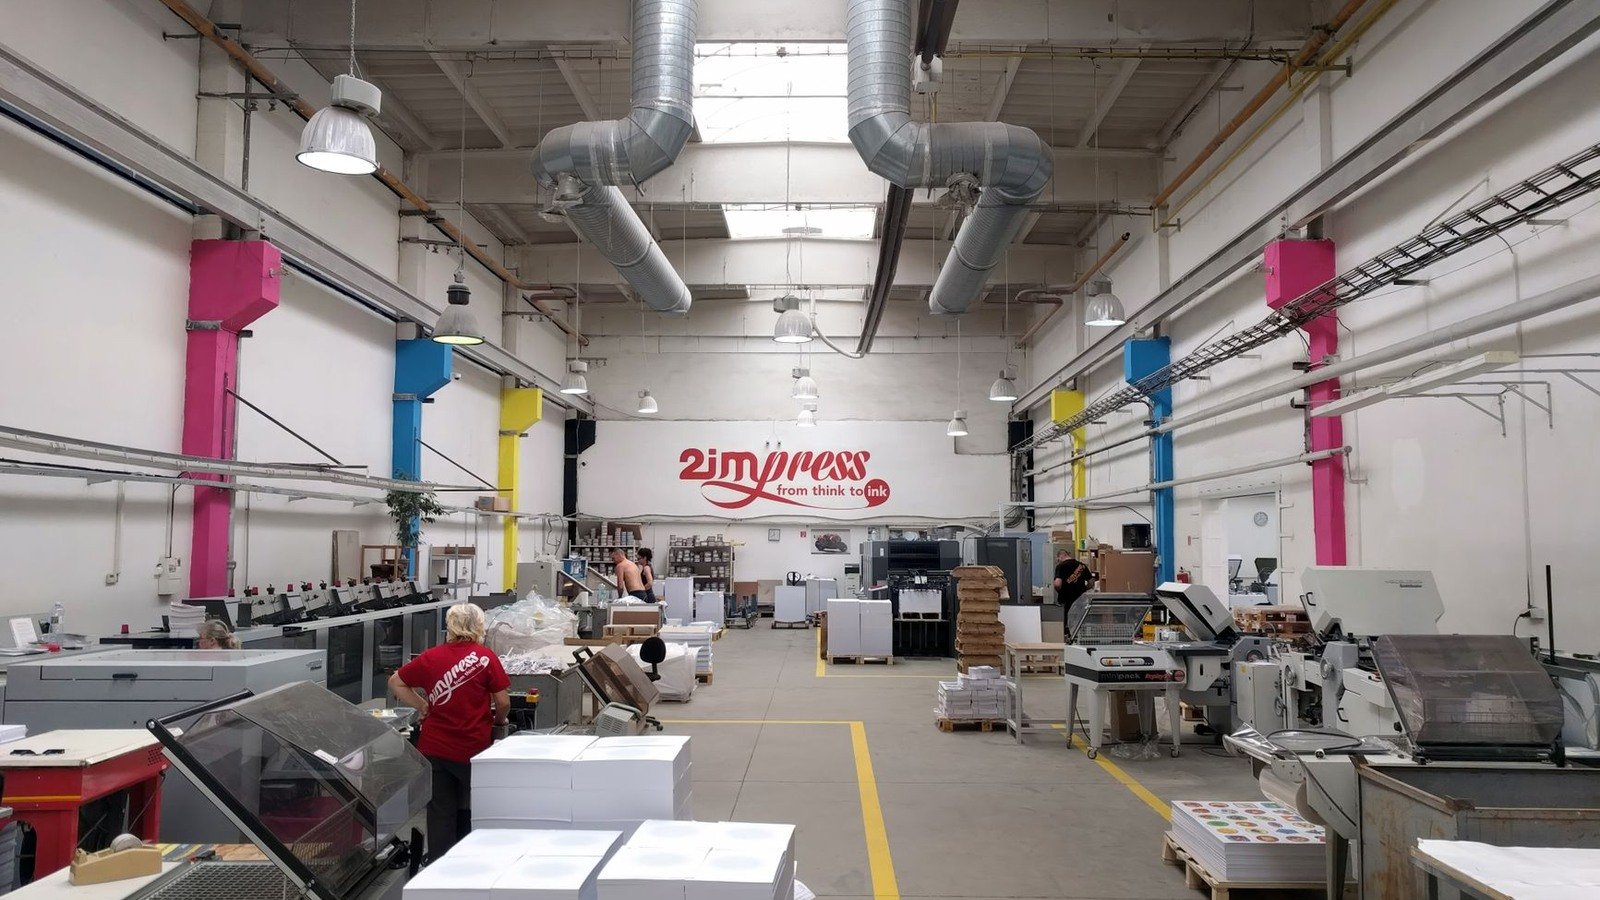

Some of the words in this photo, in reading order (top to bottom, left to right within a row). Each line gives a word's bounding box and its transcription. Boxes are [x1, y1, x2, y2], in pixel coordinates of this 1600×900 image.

[776, 484, 808, 496] from
[812, 484, 845, 496] think
[850, 485, 864, 496] to
[867, 485, 888, 497] ink
